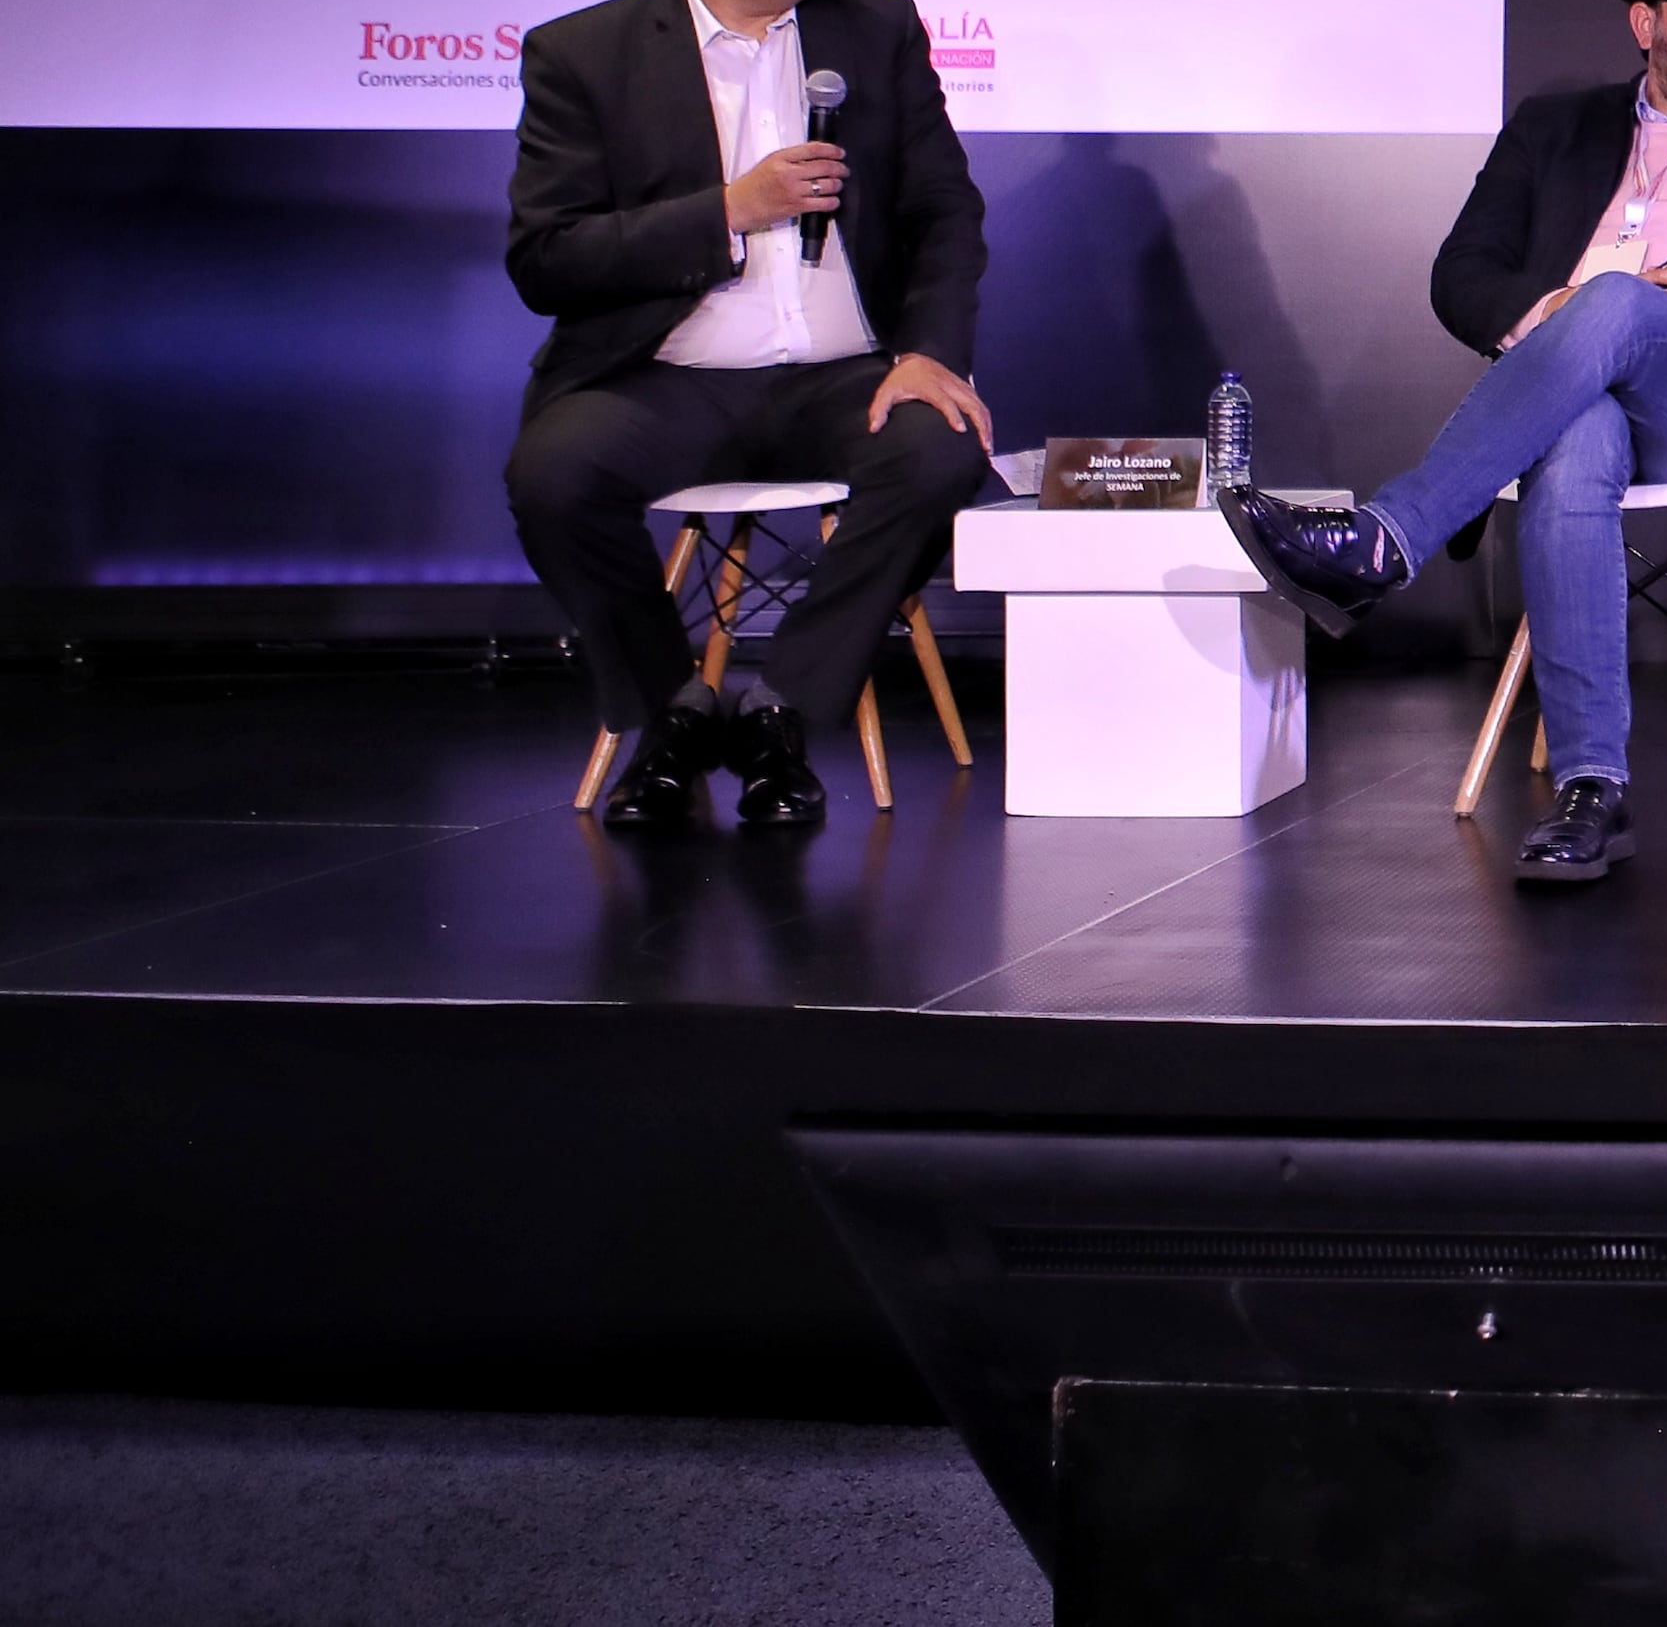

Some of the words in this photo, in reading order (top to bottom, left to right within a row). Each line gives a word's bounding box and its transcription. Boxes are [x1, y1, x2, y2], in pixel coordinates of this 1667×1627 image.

[359, 22, 484, 61] Foros
[940, 51, 993, 67] NACIÓN
[357, 70, 494, 89] Conversaciones
[1088, 455, 1121, 469] Jairo
[1124, 456, 1172, 469] Lozano
[1074, 472, 1092, 482] Jefe
[1093, 472, 1105, 481] de
[1105, 472, 1169, 482] Investigaciones
[1170, 472, 1182, 481] de
[1106, 483, 1145, 492] SEMANA
